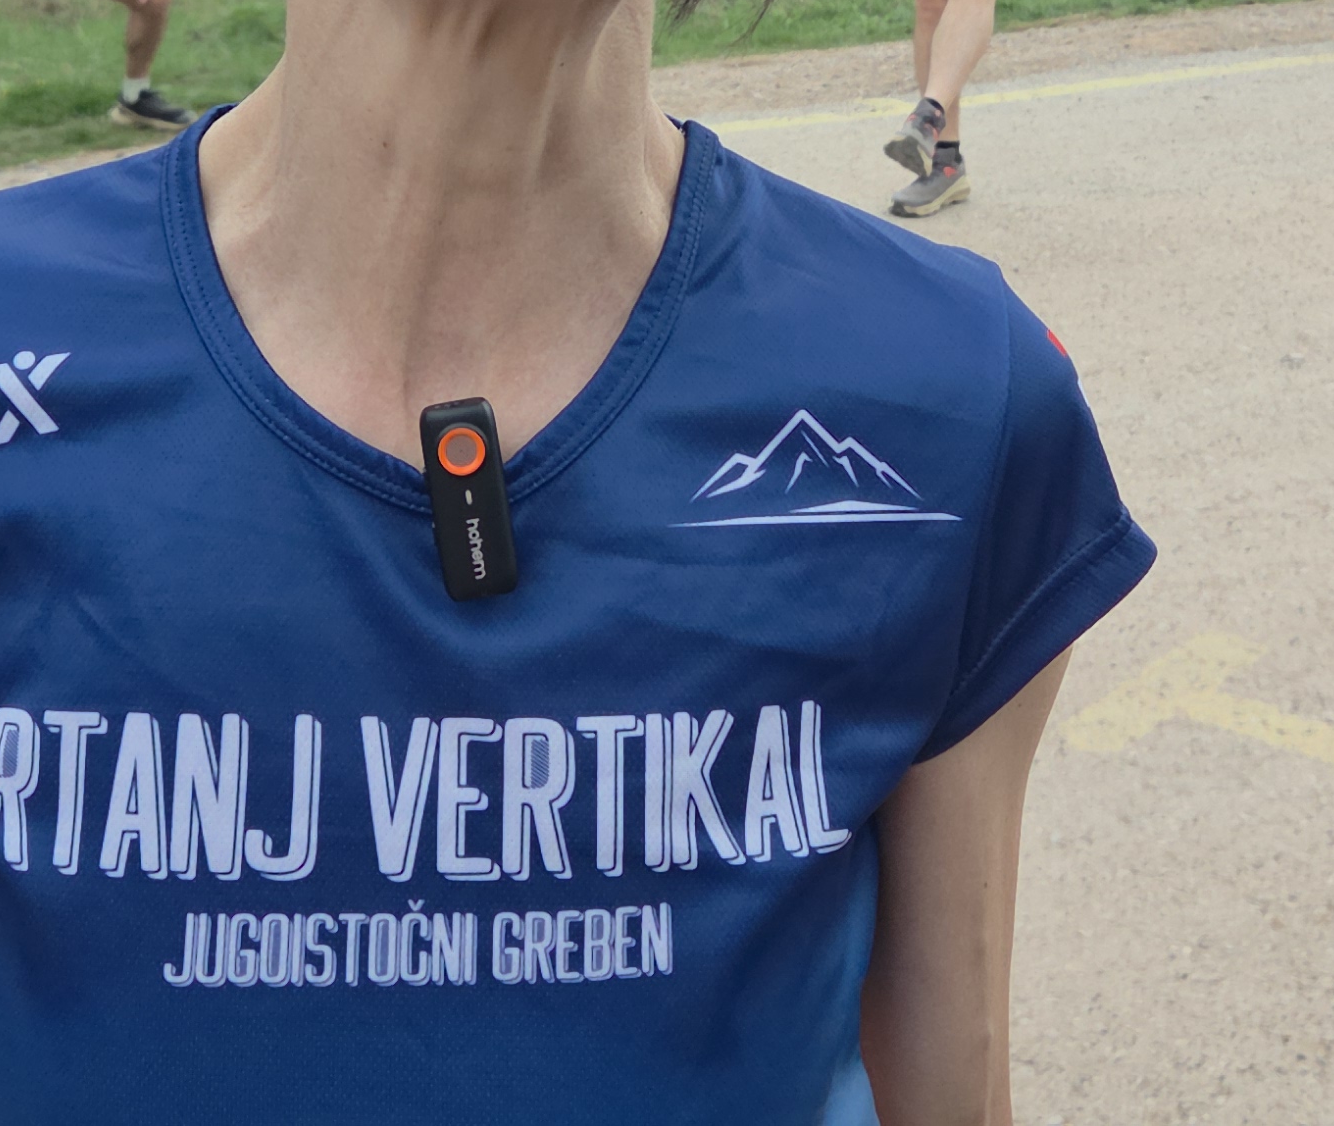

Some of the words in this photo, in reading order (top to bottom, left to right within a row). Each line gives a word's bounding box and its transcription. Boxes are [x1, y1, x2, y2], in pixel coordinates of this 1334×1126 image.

[466, 517, 487, 580] hohem
[360, 700, 853, 883] VERTIKAL
[163, 899, 478, 988] JUGOISTOČNI
[491, 902, 674, 986] GREBEN
